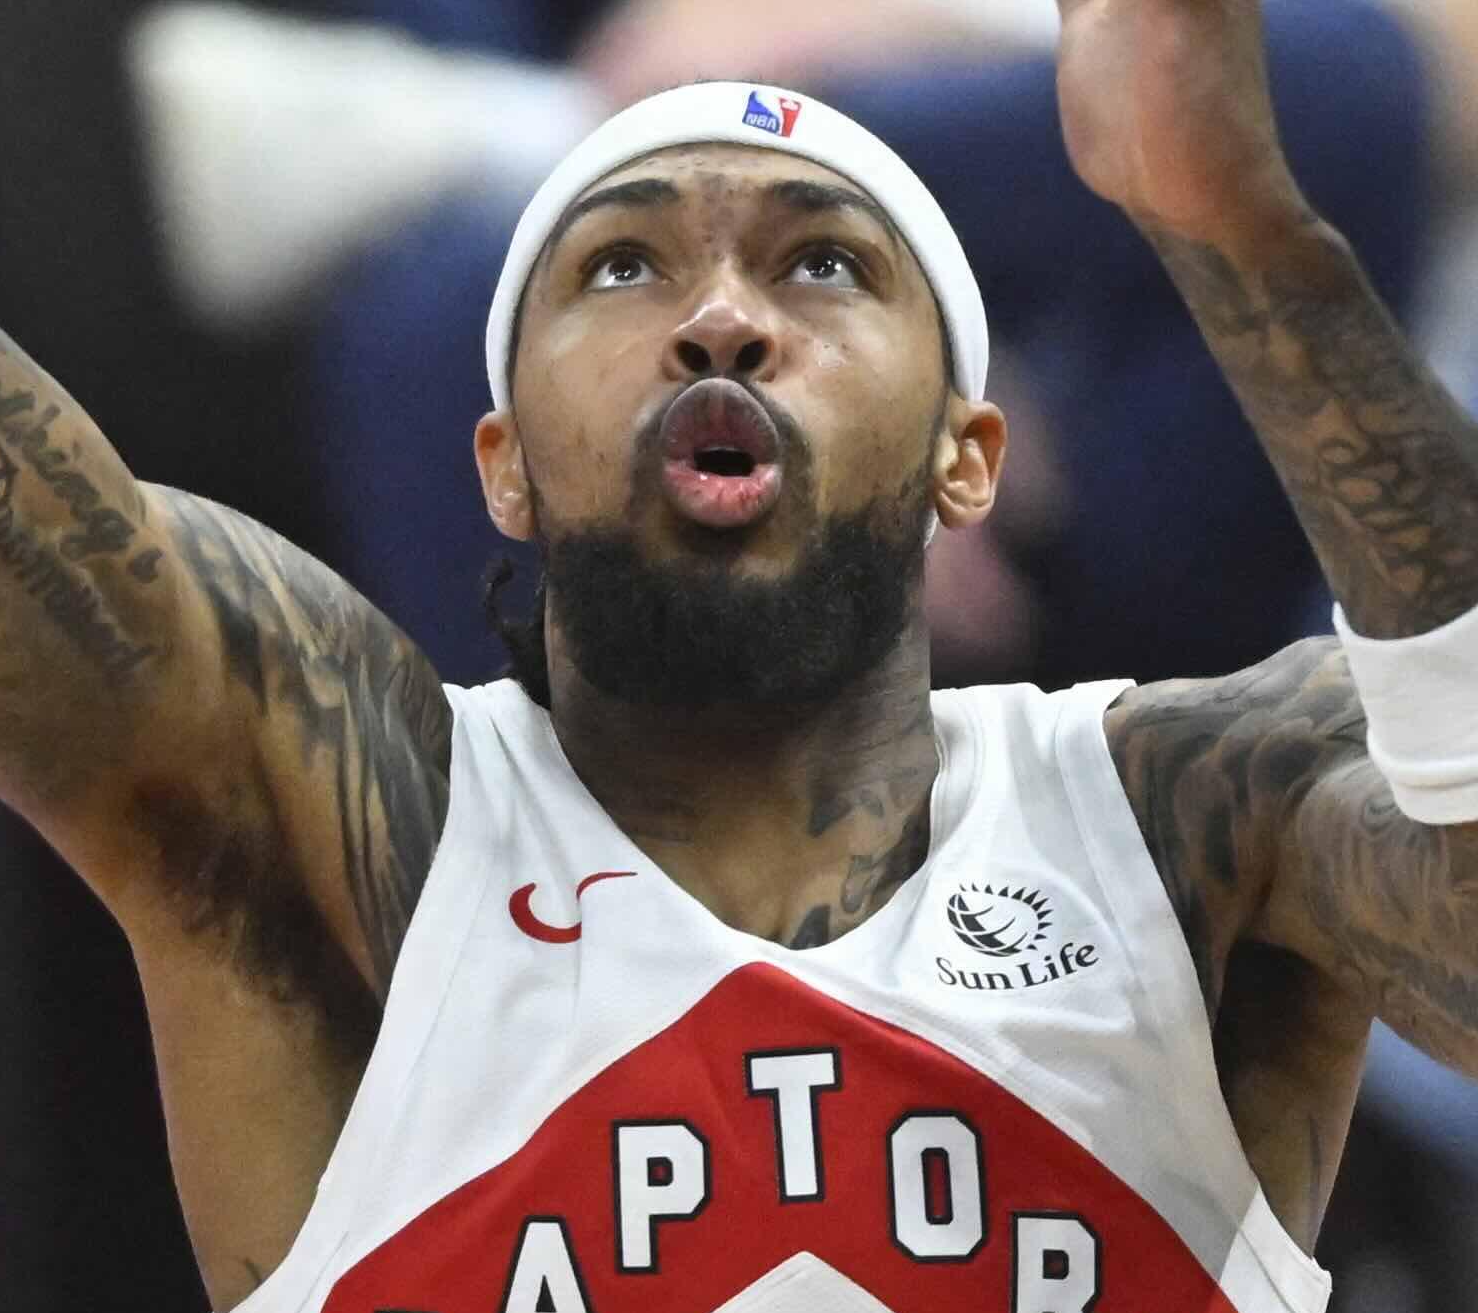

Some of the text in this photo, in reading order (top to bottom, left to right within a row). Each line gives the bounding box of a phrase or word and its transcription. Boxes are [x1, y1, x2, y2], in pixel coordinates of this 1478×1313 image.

[745, 113, 778, 131] NBA
[935, 941, 1100, 990] Sun Life
